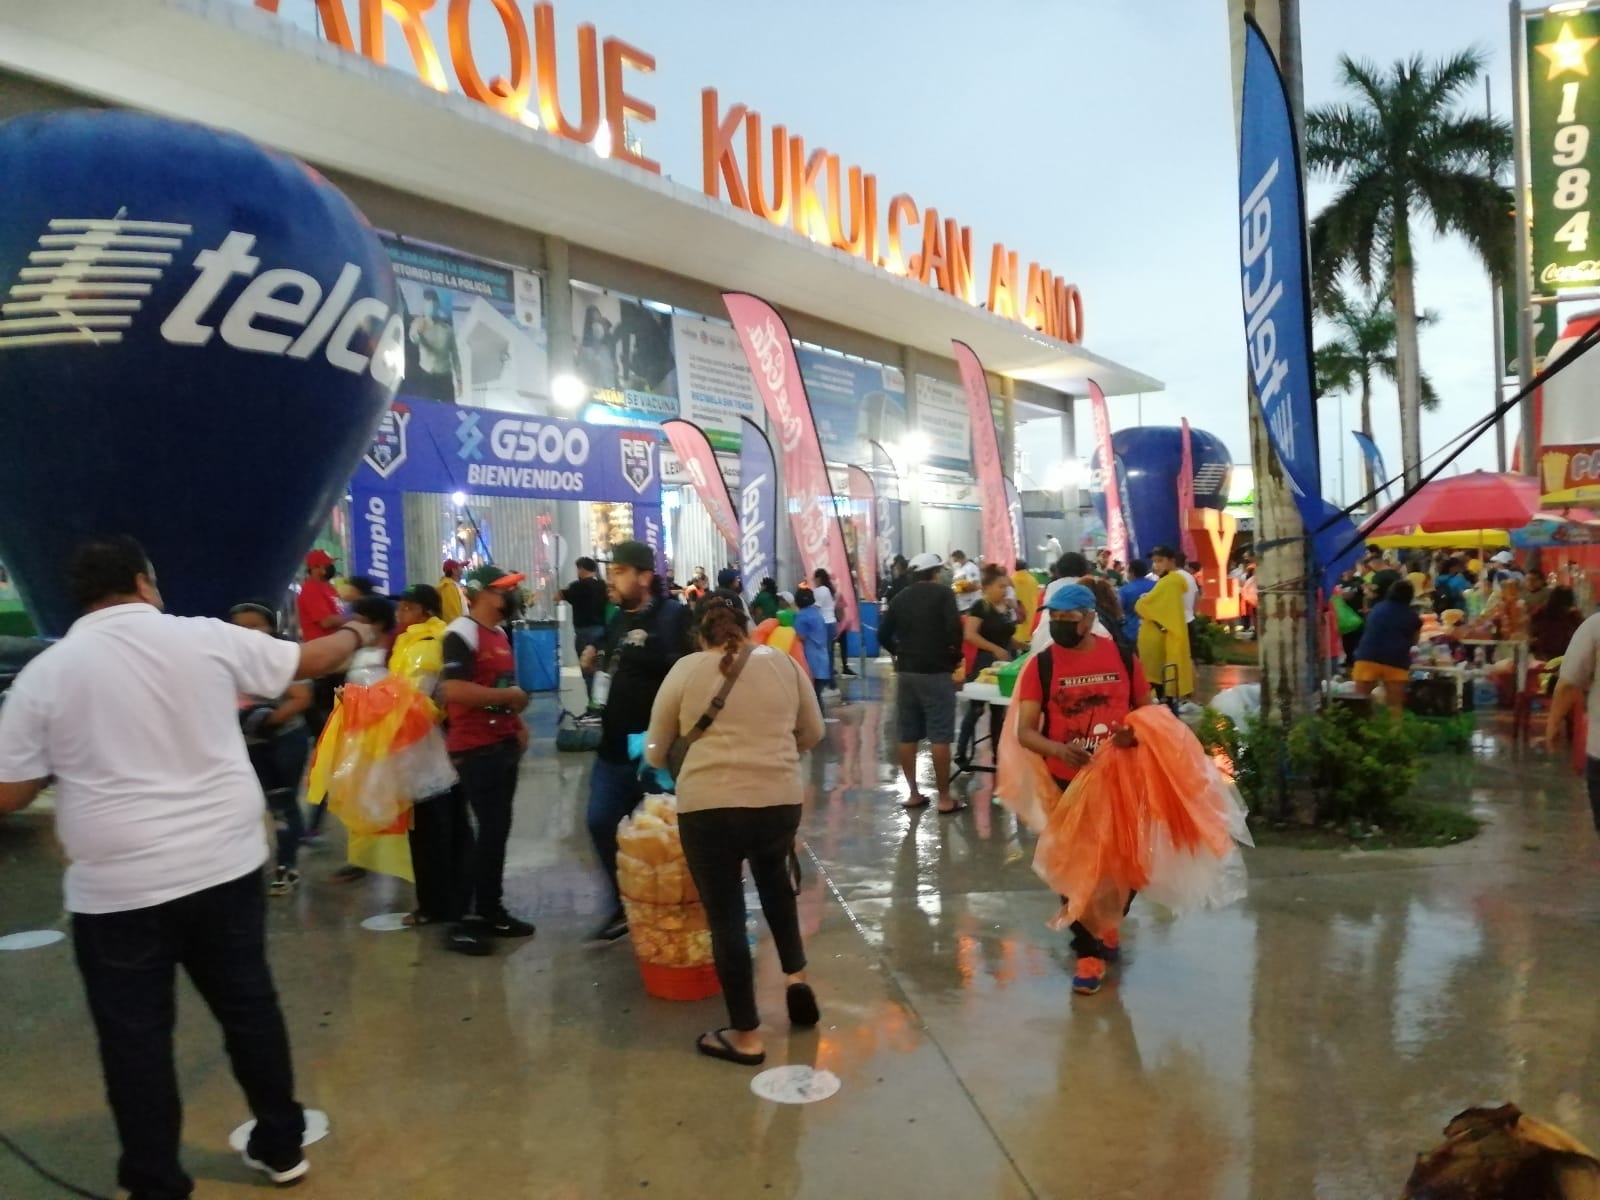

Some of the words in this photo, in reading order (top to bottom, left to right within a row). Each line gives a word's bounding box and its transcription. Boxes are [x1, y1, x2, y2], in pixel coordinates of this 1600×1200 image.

[702, 86, 977, 306] KUKULCAN
[1552, 82, 1592, 252] 1984
[467, 463, 584, 492] BIENVENIDOS
